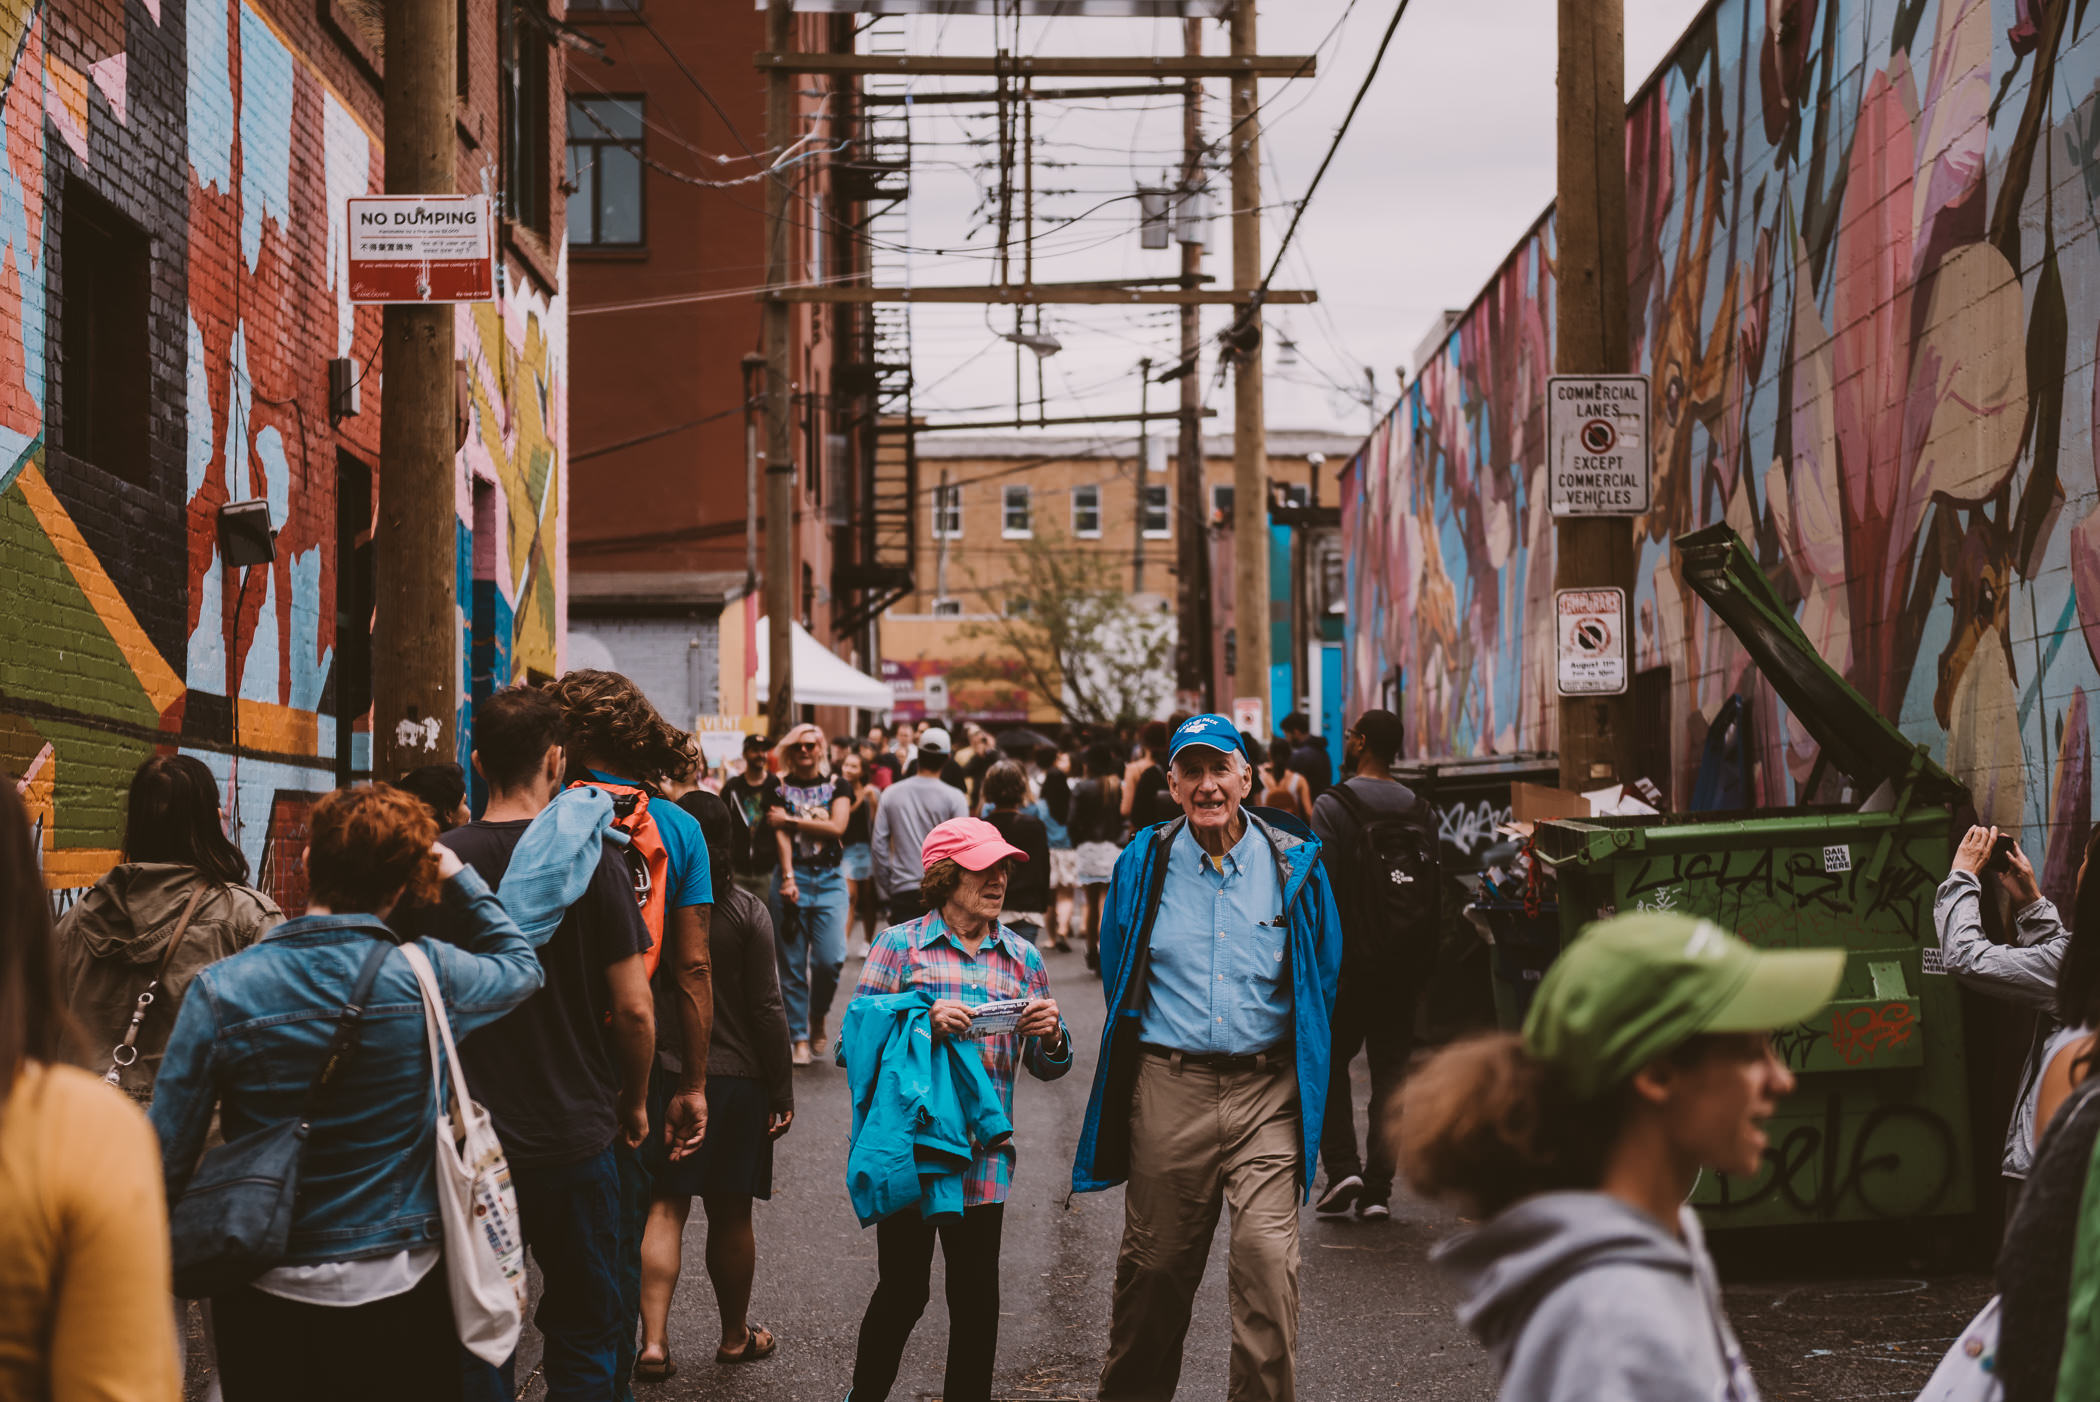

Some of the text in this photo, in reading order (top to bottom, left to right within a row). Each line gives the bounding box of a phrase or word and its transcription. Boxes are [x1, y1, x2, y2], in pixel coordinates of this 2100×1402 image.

[361, 212, 477, 225] NO DUMPING
[1558, 386, 1638, 401] COMMERCIAL
[1576, 403, 1620, 418] LANES
[1573, 456, 1624, 470] EXCEPT
[1558, 474, 1639, 488] COMMERCIAL
[1566, 490, 1632, 505] VEHICLES
[1824, 847, 1845, 856] DAIL
[1826, 862, 1850, 870] HERE
